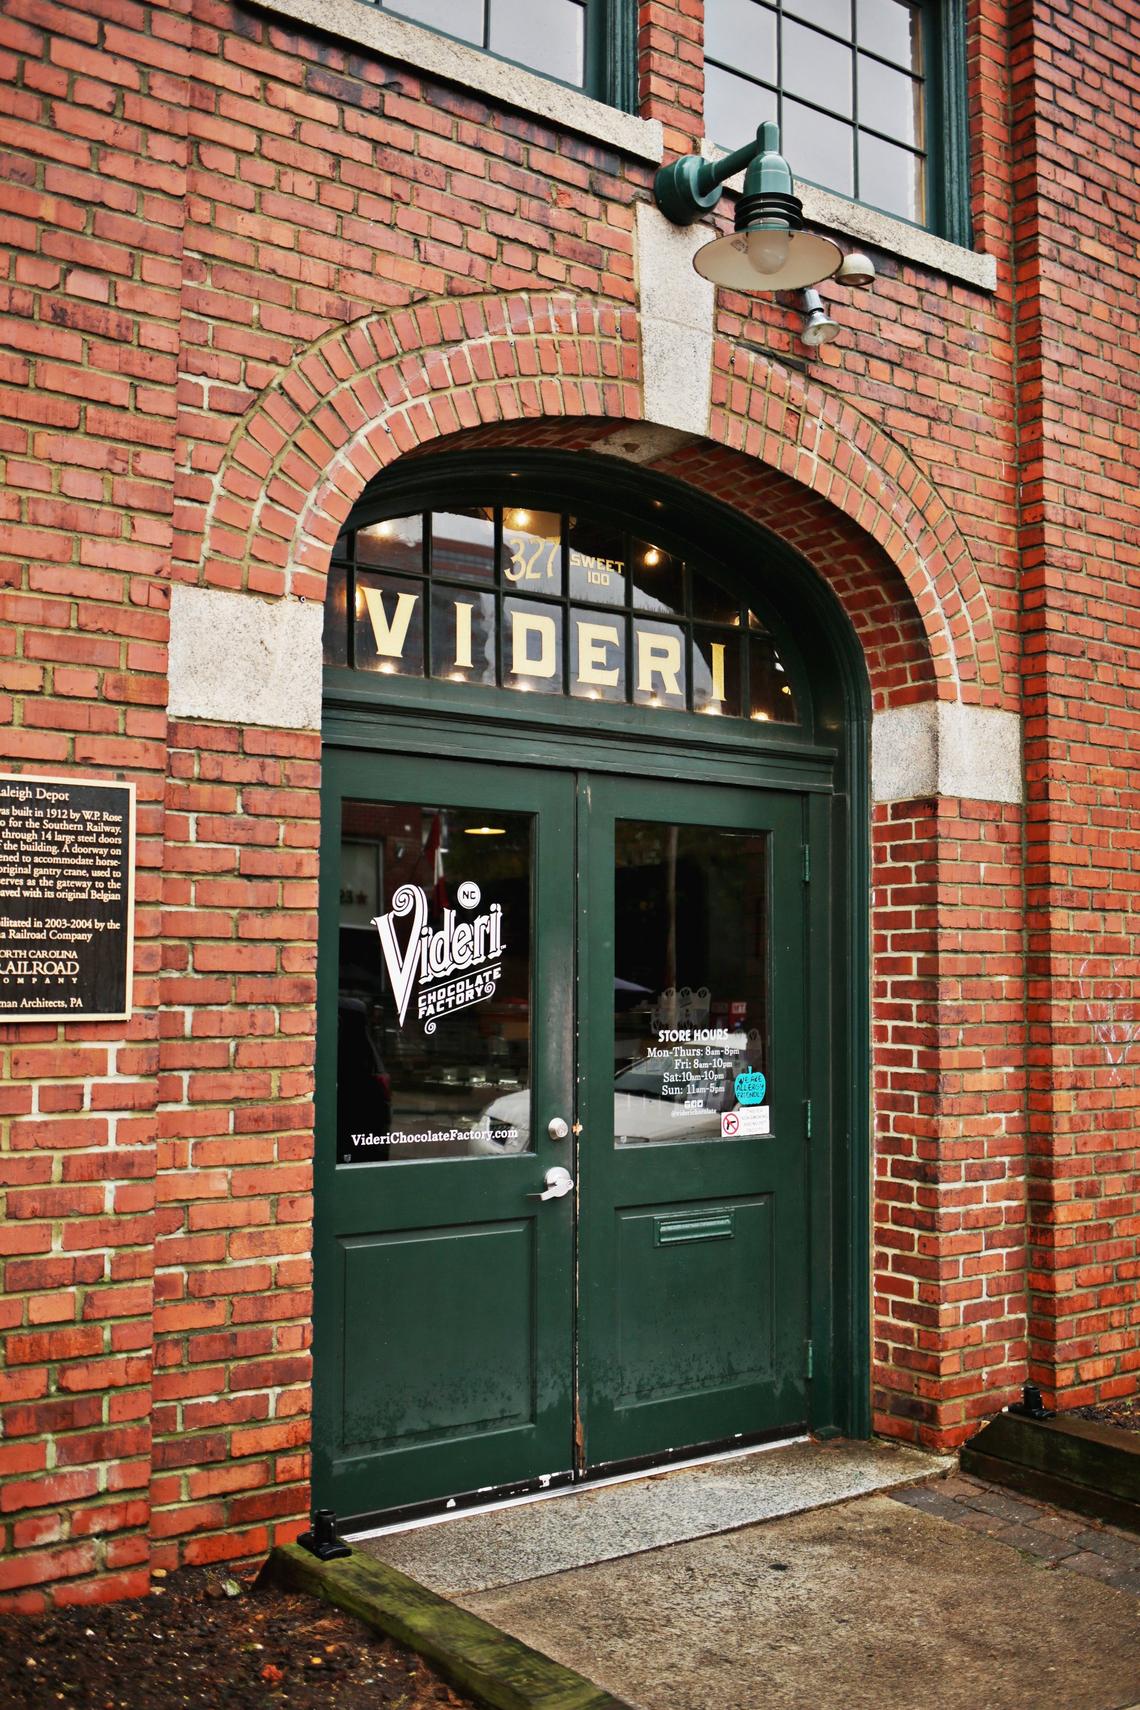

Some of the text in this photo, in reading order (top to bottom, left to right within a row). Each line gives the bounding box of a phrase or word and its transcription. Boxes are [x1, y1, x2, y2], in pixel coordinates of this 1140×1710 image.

[504, 536, 560, 581] 327
[569, 552, 625, 574] SWEET
[587, 571, 610, 586] 100
[361, 586, 727, 702] VIDERI
[0, 785, 70, 803] aleigh Depot
[12, 805, 33, 817] built
[34, 808, 44, 817] in
[46, 808, 68, 819] 1912
[69, 809, 81, 822] by
[81, 810, 100, 821] W.P.
[102, 811, 123, 822] Rose
[9, 817, 23, 828] for
[25, 818, 40, 829] the
[43, 819, 84, 831] Southern
[86, 821, 122, 836] Railway.
[2, 828, 122, 845] through 14 large steel doors
[3, 840, 18, 851] the
[20, 840, 60, 856] building.
[61, 843, 70, 853] A
[71, 843, 109, 858] doorway
[110, 848, 122, 856] on
[22, 855, 32, 863] to
[33, 854, 94, 866] accommodate
[95, 855, 121, 867] horse-
[33, 867, 62, 878] gantry
[63, 868, 90, 878] crane,
[91, 867, 111, 878] used
[112, 870, 122, 878] to
[26, 878, 37, 886] as
[39, 876, 54, 887] the
[56, 879, 92, 890] gateway
[95, 881, 105, 889] to
[107, 878, 122, 889] the
[22, 887, 43, 898] with
[44, 888, 55, 898] its
[56, 888, 89, 902] original
[90, 889, 121, 903] Belgian
[462, 890, 477, 900] NC
[33, 918, 43, 928] in
[44, 918, 93, 930] 2003-2004
[94, 918, 106, 932] by
[107, 919, 121, 930] the
[8, 929, 47, 940] Railroad
[49, 930, 93, 943] Company
[28, 949, 79, 959] CAROLINA
[370, 883, 507, 1028] Videri
[418, 966, 502, 1008] CHOCOLATE
[20, 997, 68, 1009] Architects,
[69, 997, 84, 1008] PA
[418, 984, 484, 1020] FACTORY
[658, 1028, 729, 1042] STORE HOURS
[646, 1046, 740, 1058] Mon-Thurs: 8am-8pm
[674, 1058, 733, 1070] Fri: 8am-10pm
[661, 1083, 726, 1096] Sun: 11am-5pm
[351, 1128, 518, 1146] VideriChocolateFactory.com
